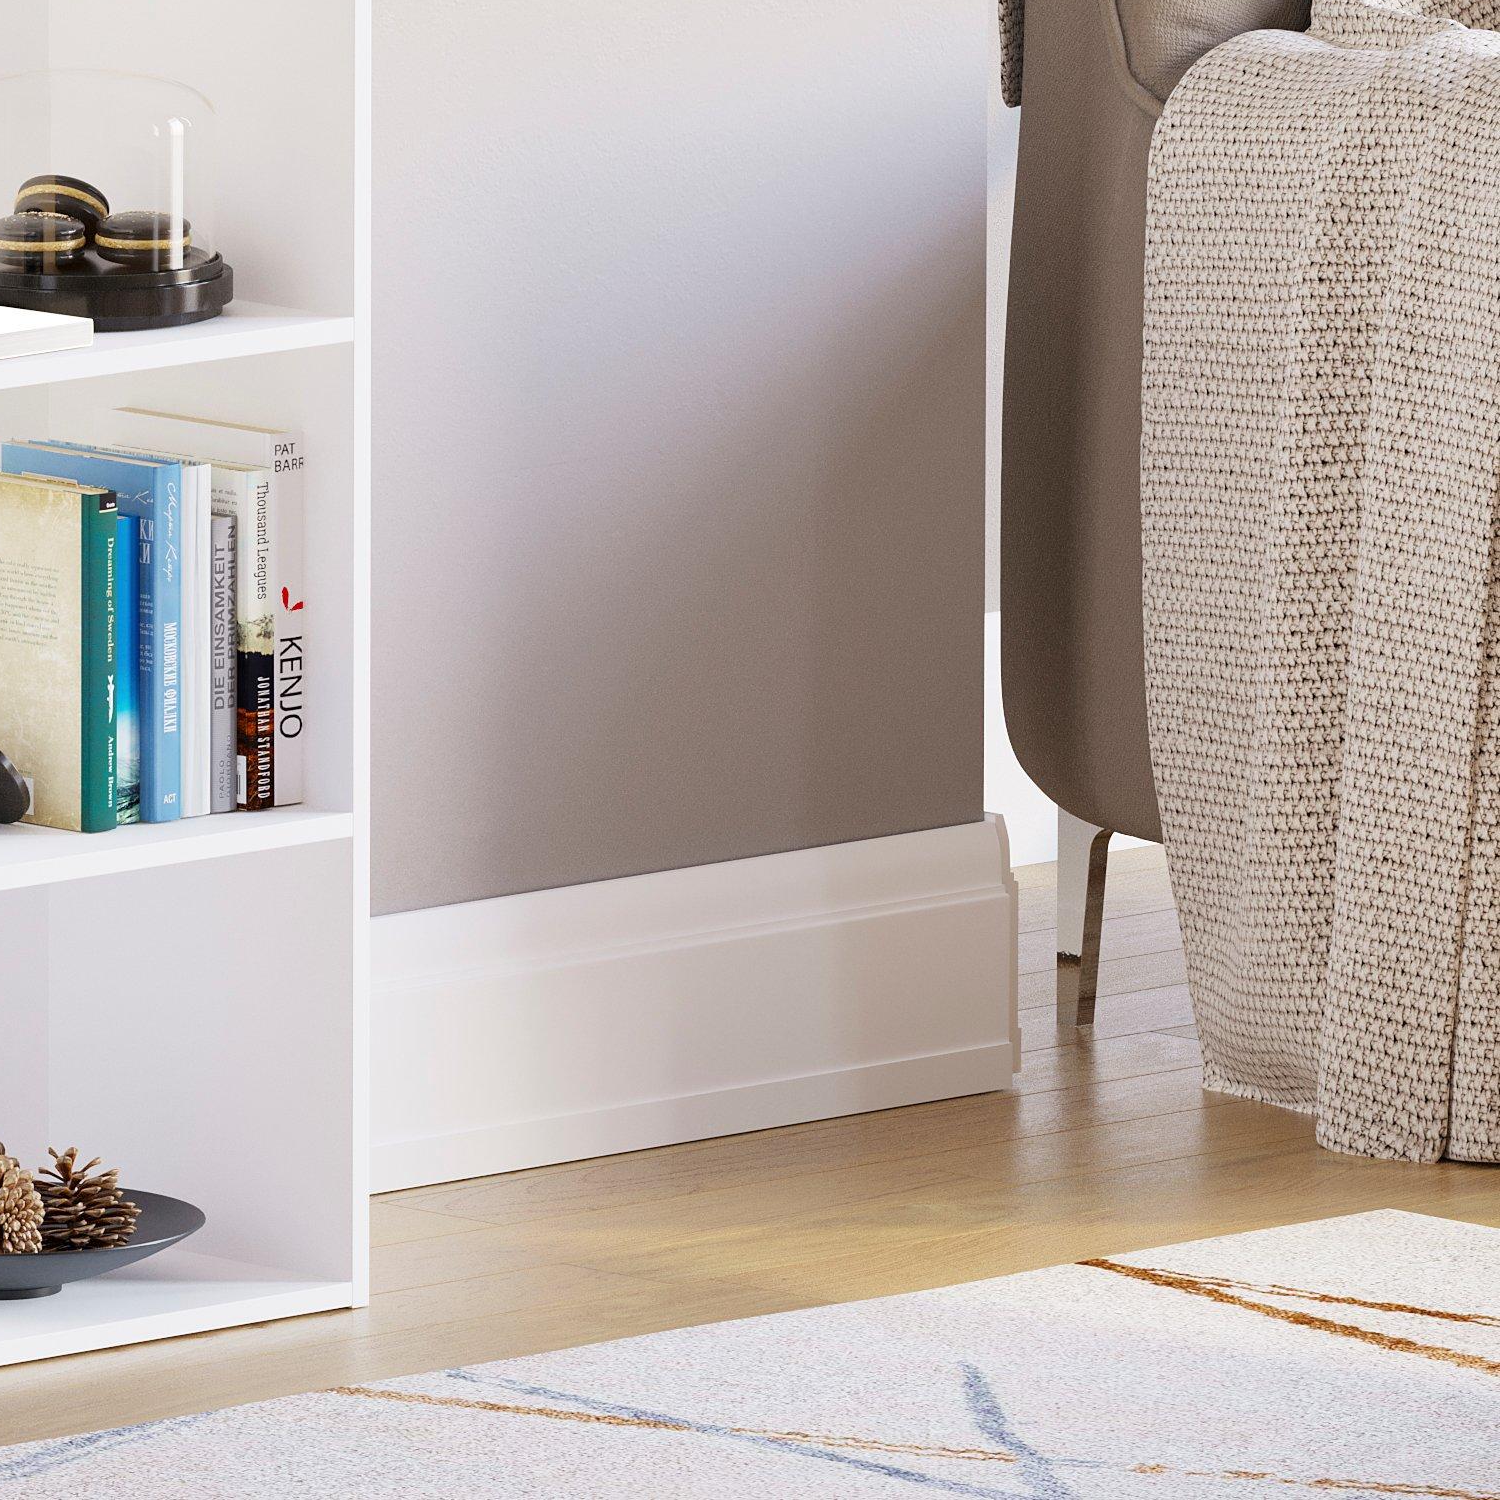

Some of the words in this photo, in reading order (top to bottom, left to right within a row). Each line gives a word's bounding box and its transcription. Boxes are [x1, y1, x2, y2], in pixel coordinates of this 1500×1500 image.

[274, 442, 296, 456] PAT
[257, 482, 269, 545] Thousand
[106, 537, 115, 598] Dreaming
[227, 525, 236, 660] PRIMZAHLEN
[254, 549, 269, 600] Leagues
[107, 599, 114, 612] of
[214, 544, 225, 670] EINSAMKEIT
[214, 676, 225, 710] DIE
[227, 666, 236, 709] DER
[257, 676, 270, 732] JONATHAN
[280, 636, 303, 738] KENJO
[257, 736, 271, 799] STANDFORD
